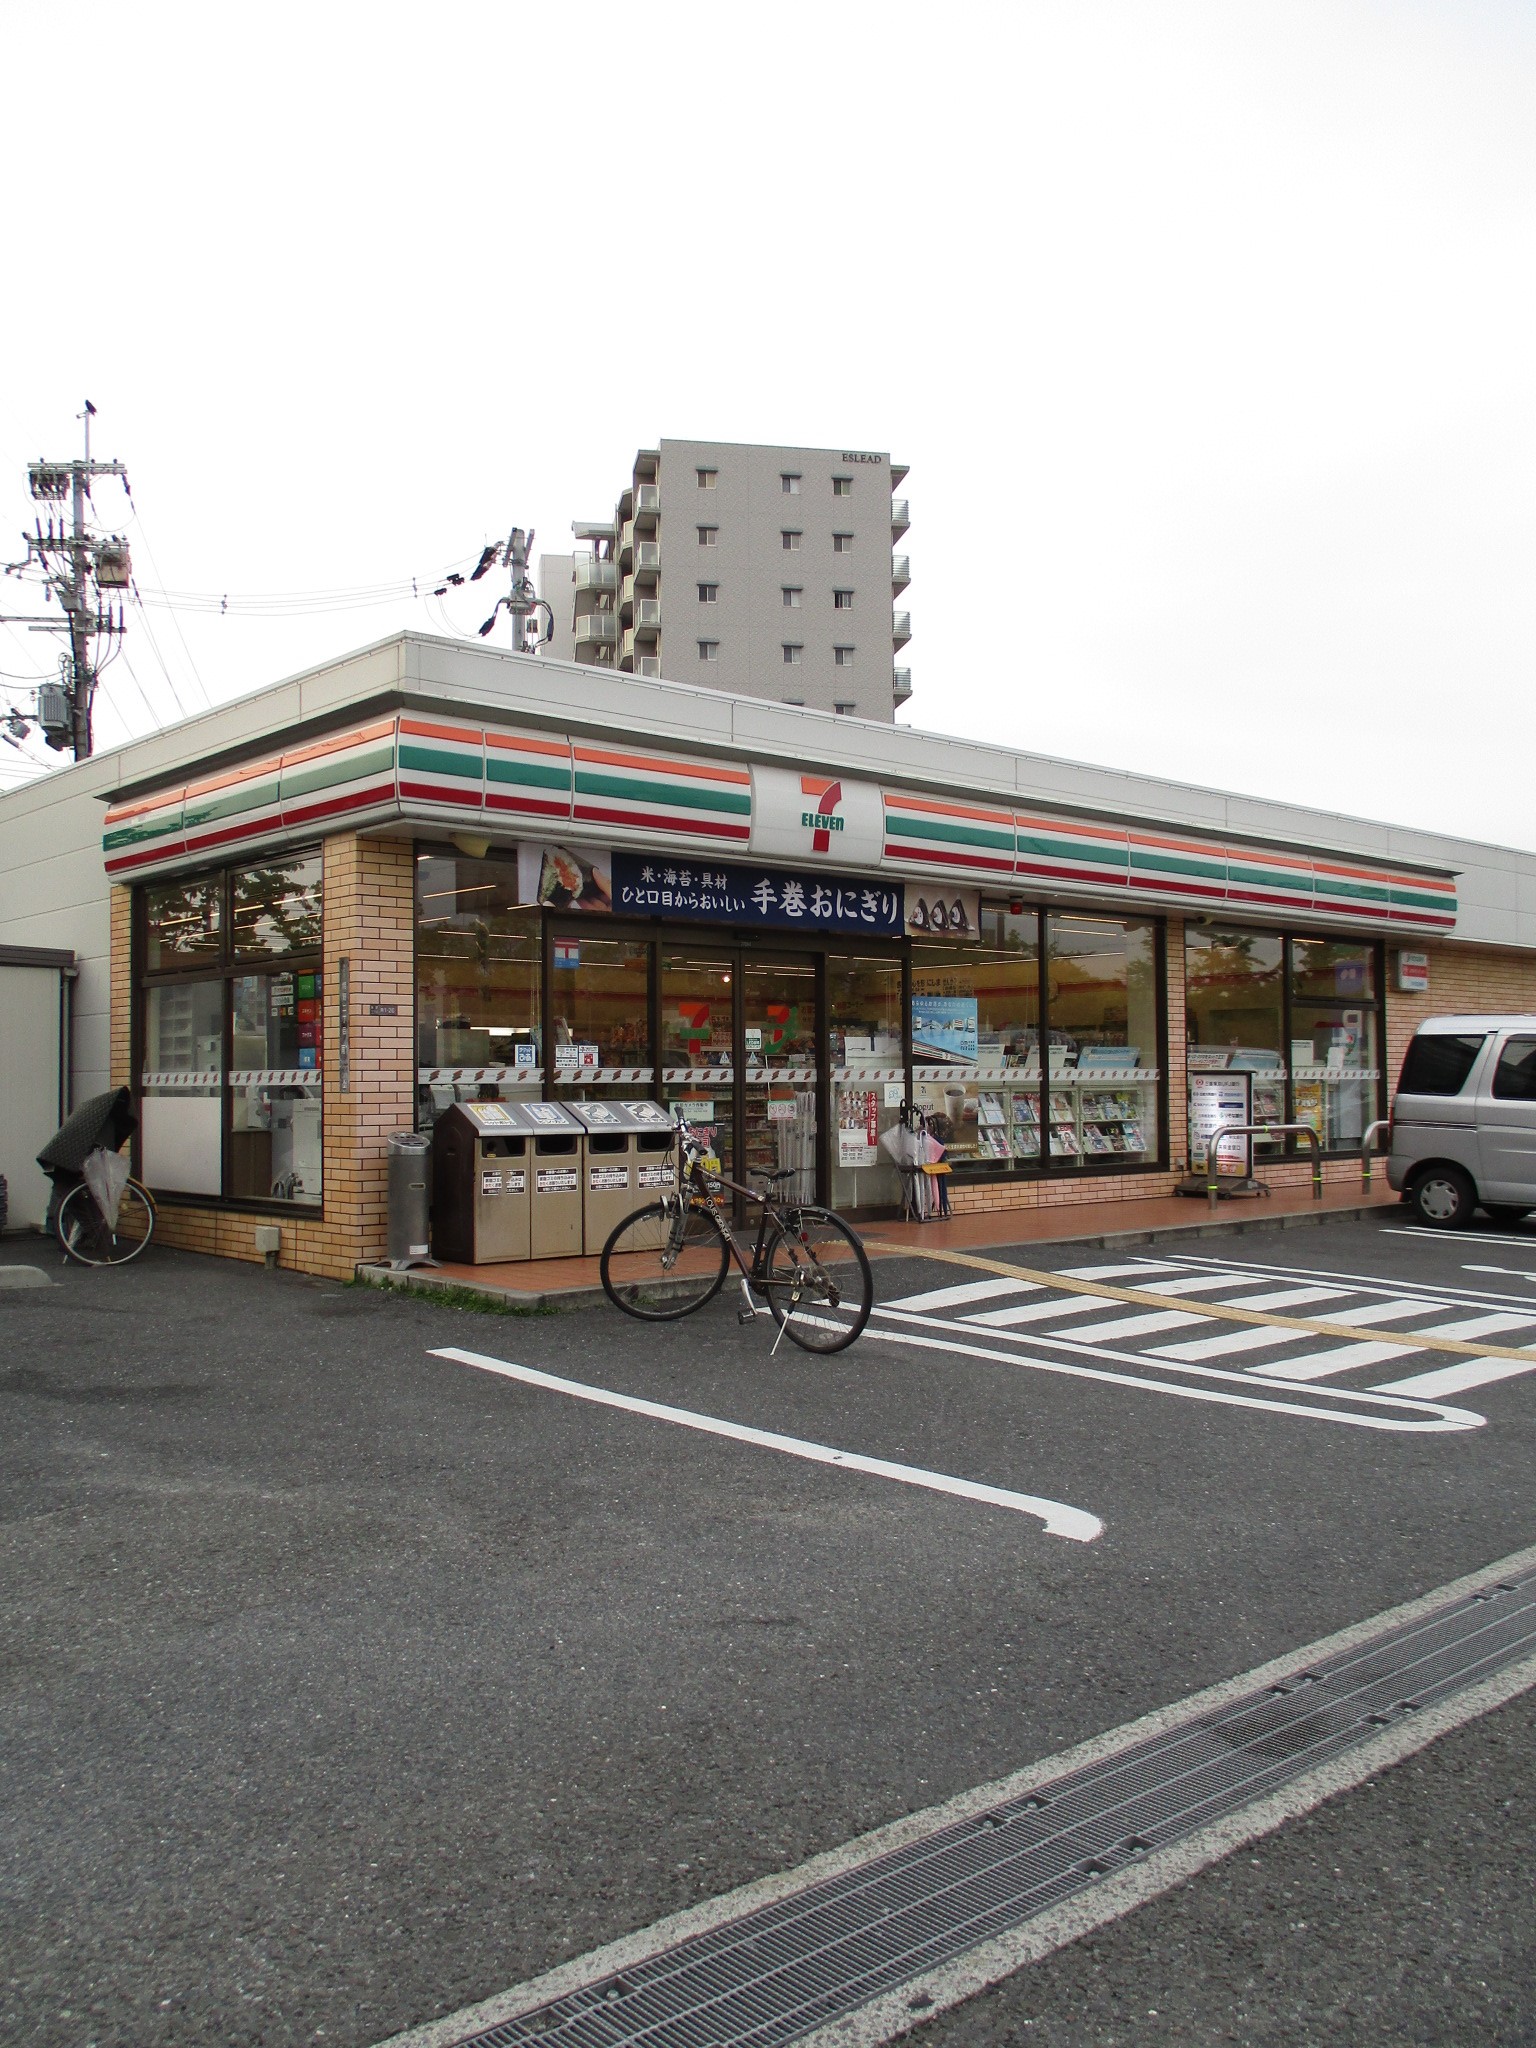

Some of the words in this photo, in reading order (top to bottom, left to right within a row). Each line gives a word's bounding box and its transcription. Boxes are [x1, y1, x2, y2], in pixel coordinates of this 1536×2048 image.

[842, 453, 882, 464] ESLEAD
[801, 812, 844, 831] ELEVEN
[641, 866, 728, 891] 米・海苔・具材
[621, 886, 746, 912] ひと口目からおいしい
[750, 878, 898, 925] 手巻おにぎり
